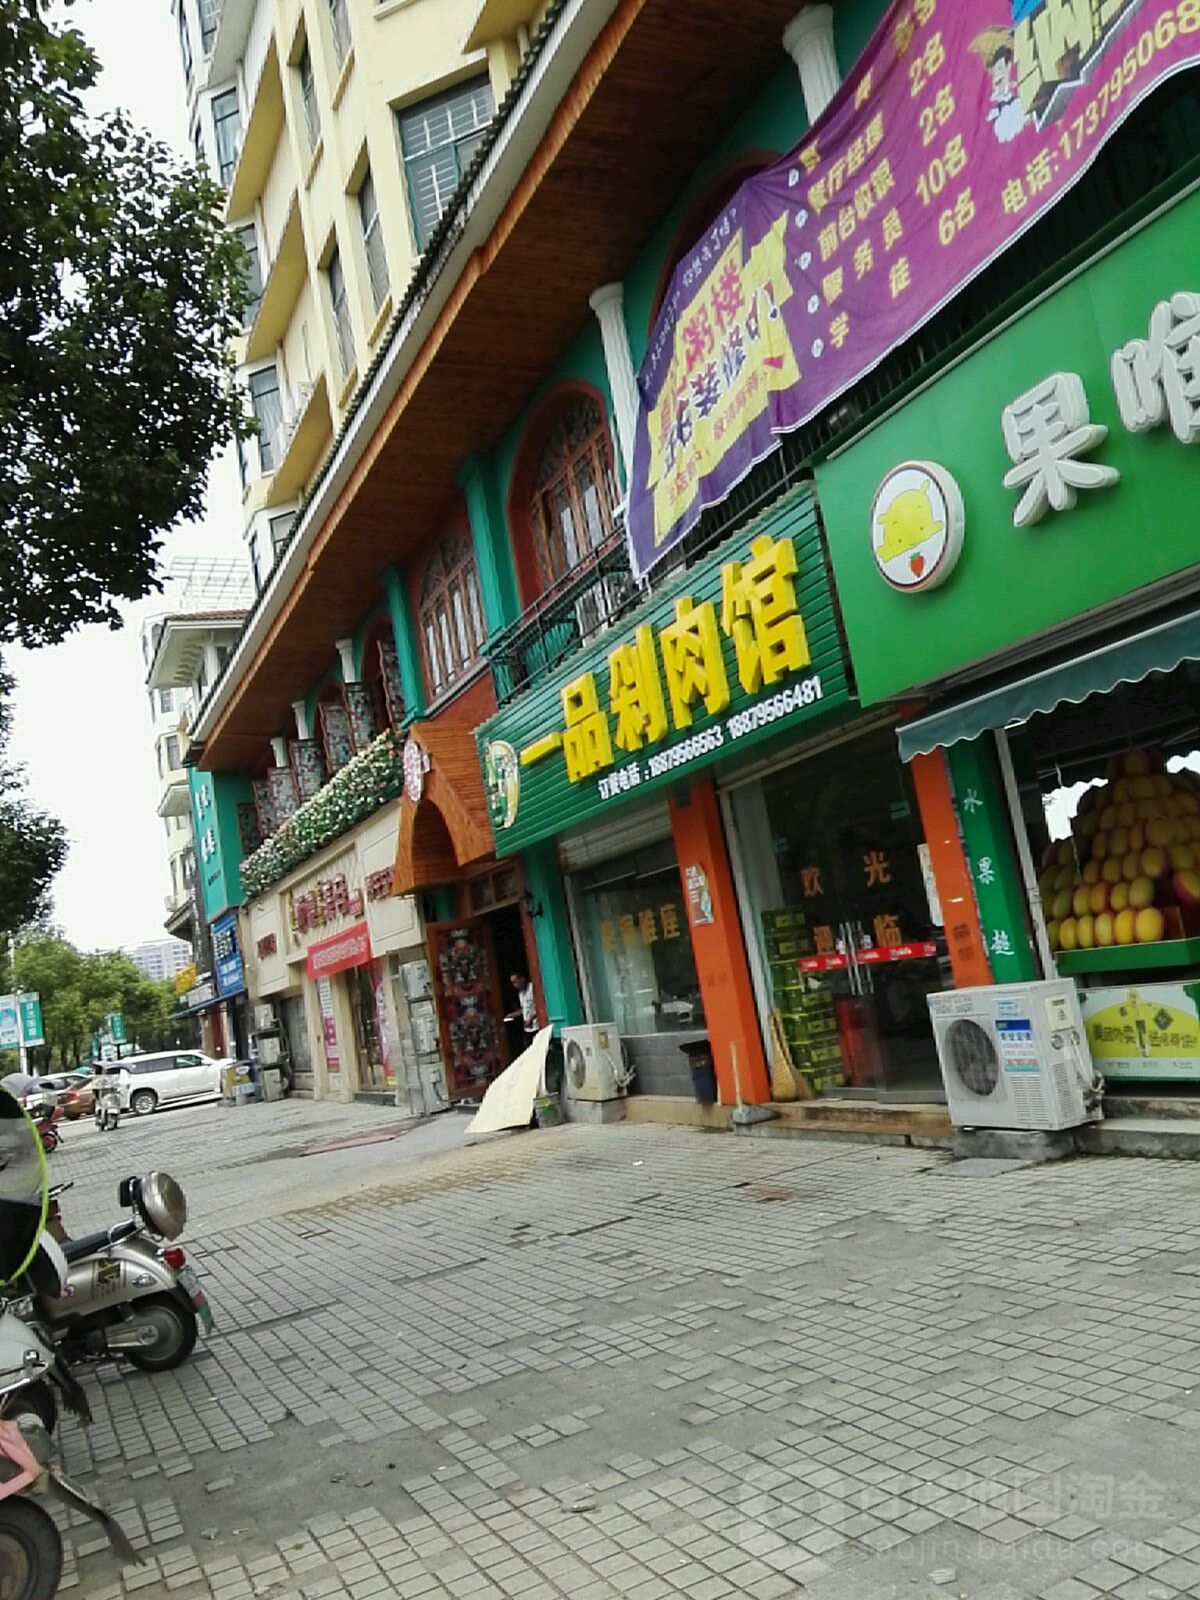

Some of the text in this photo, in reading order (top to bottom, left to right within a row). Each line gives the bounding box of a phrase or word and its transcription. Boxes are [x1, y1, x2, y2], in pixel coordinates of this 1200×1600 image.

[910, 32, 945, 96] 2名
[818, 158, 895, 262] 前台收银
[919, 82, 955, 147] 2名
[916, 133, 967, 206] 10名
[938, 187, 976, 246] 6名
[726, 676, 824, 740] 18879566481
